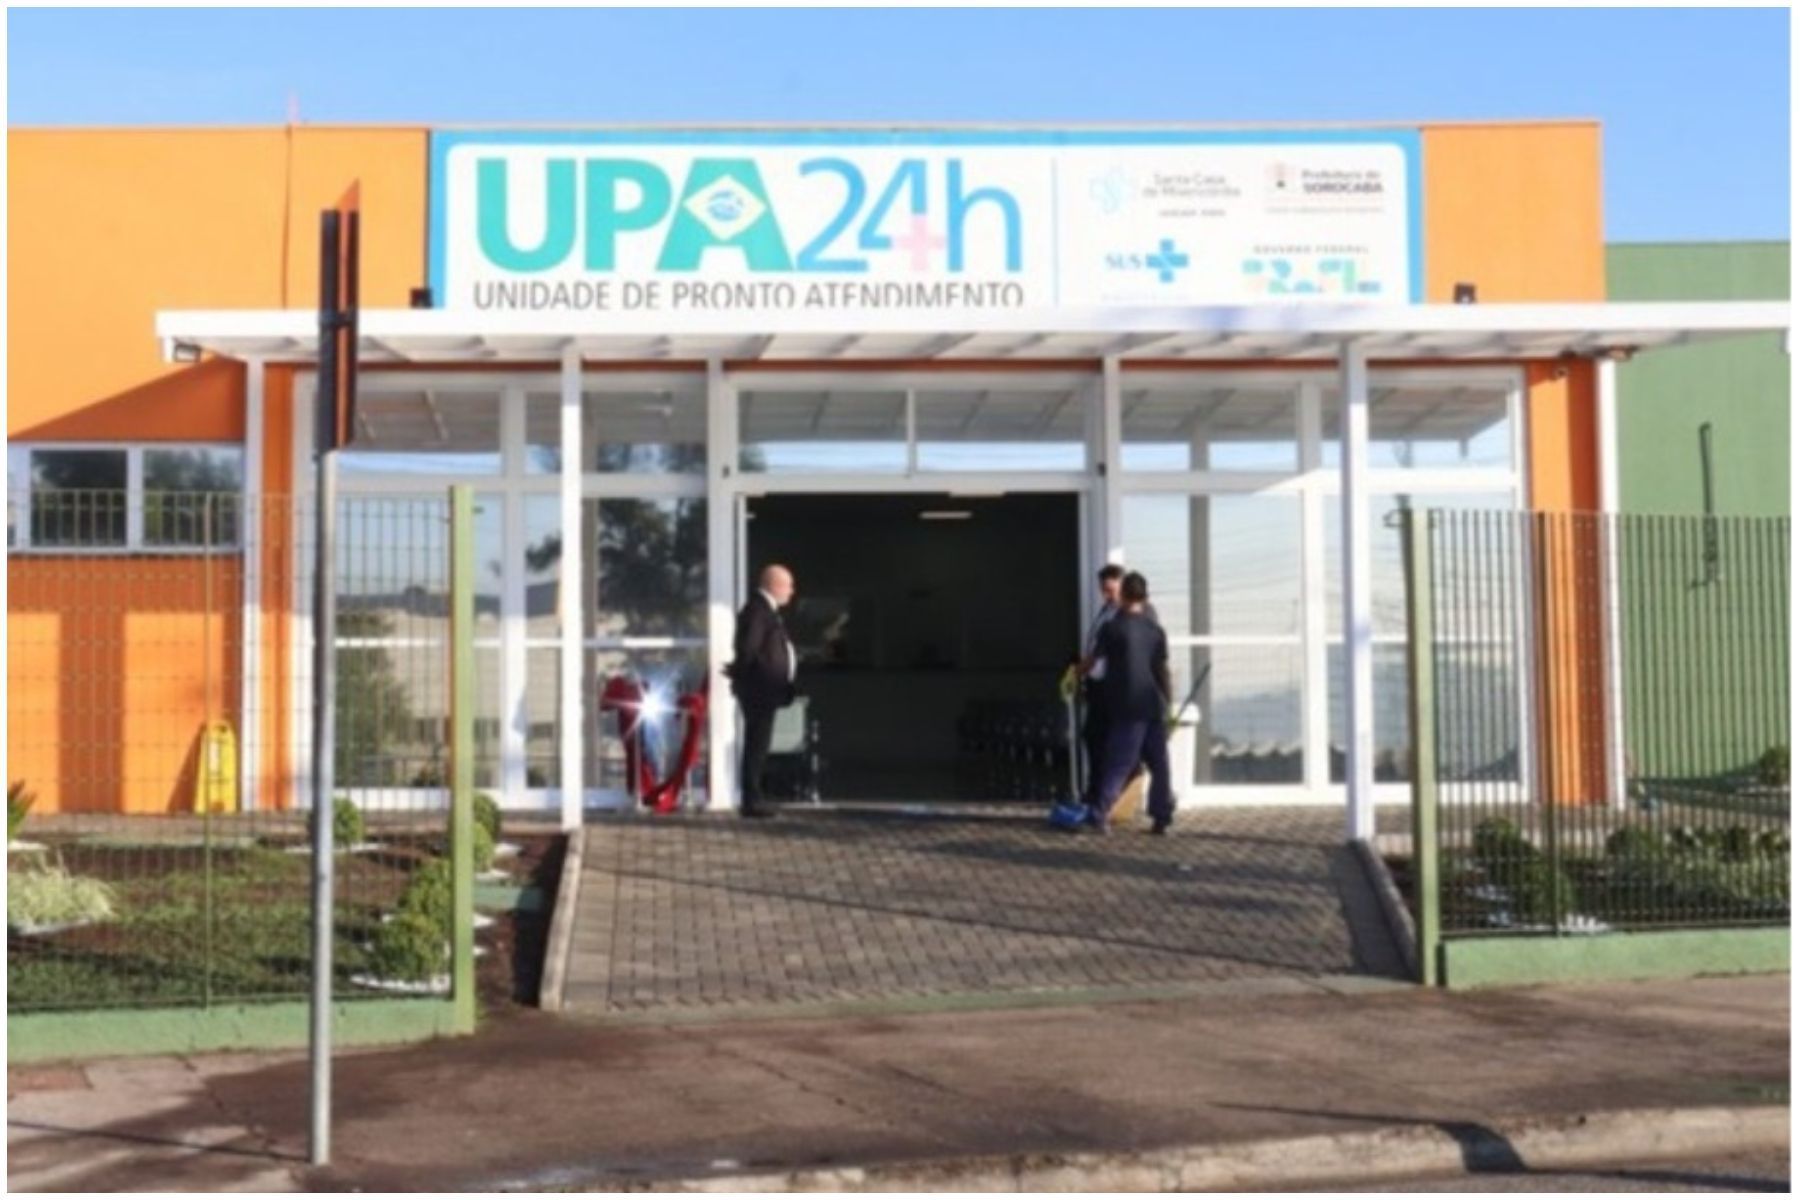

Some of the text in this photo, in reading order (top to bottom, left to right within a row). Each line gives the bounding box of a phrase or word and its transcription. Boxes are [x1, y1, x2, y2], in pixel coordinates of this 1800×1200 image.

[475, 157, 1023, 274] UPA 24h
[473, 281, 1024, 310] UNIDADE DE PRONTO ATENDIMENTO
